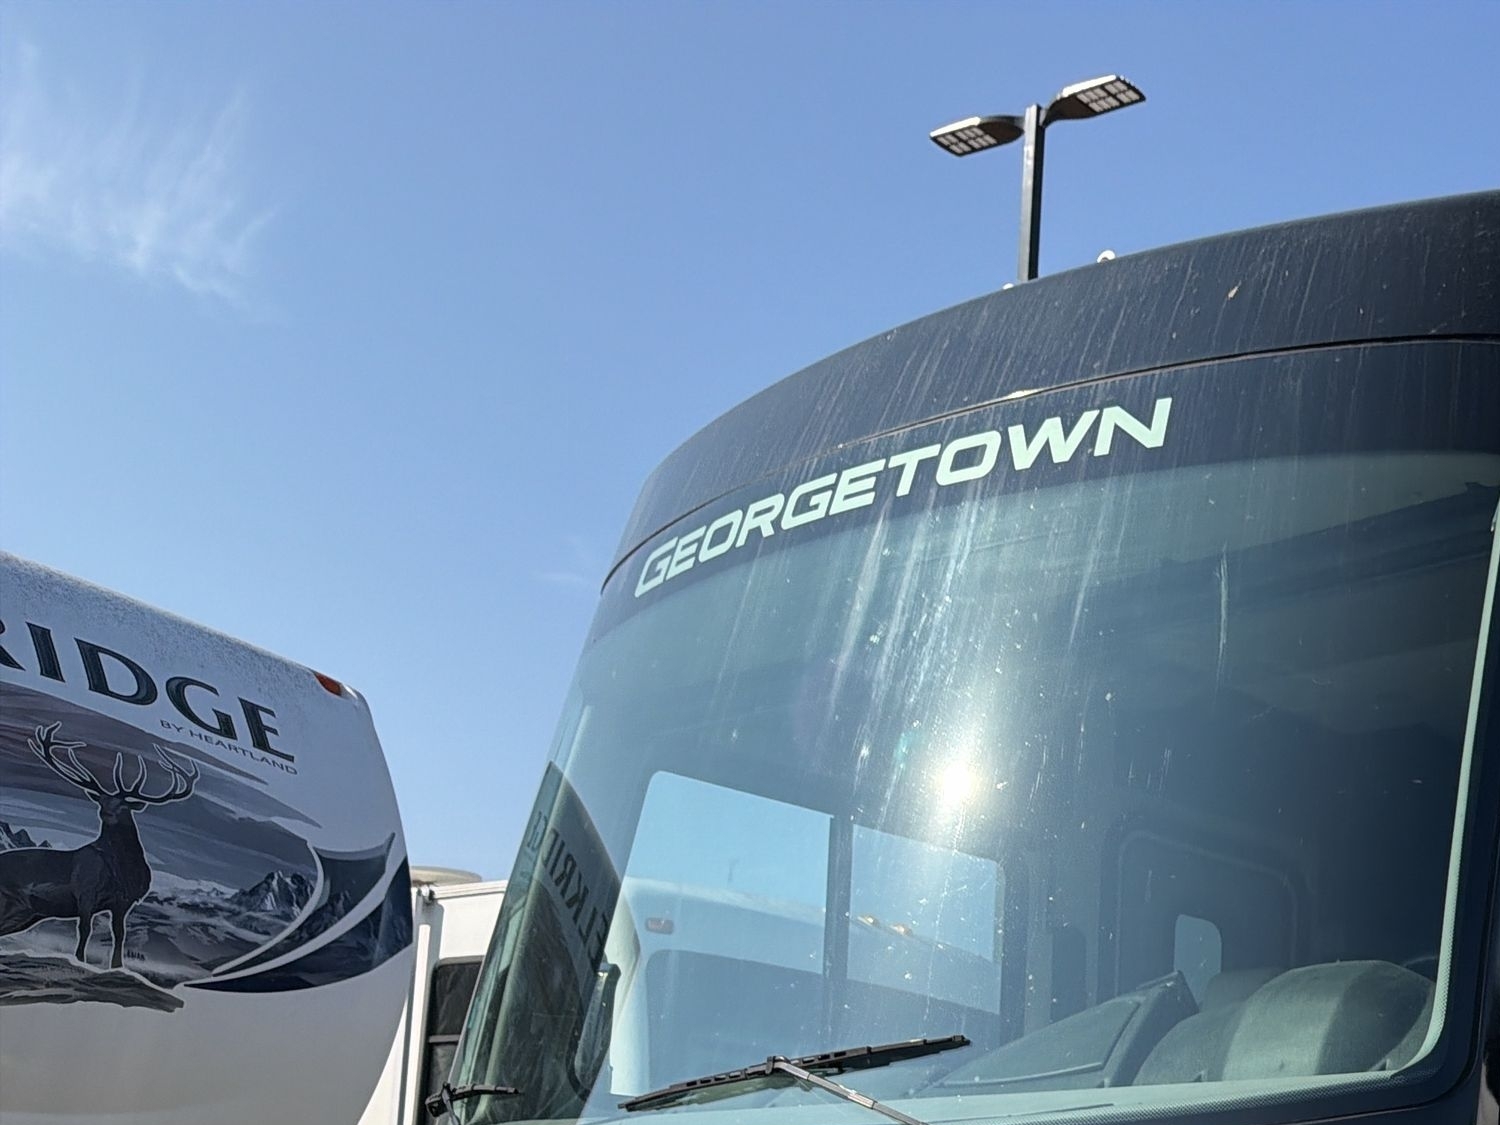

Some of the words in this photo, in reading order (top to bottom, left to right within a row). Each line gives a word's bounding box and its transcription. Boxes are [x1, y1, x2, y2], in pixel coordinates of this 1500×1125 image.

[634, 397, 1172, 598] GEORGETOWN
[160, 719, 184, 733] BY
[189, 729, 298, 776] HEARTLAND
